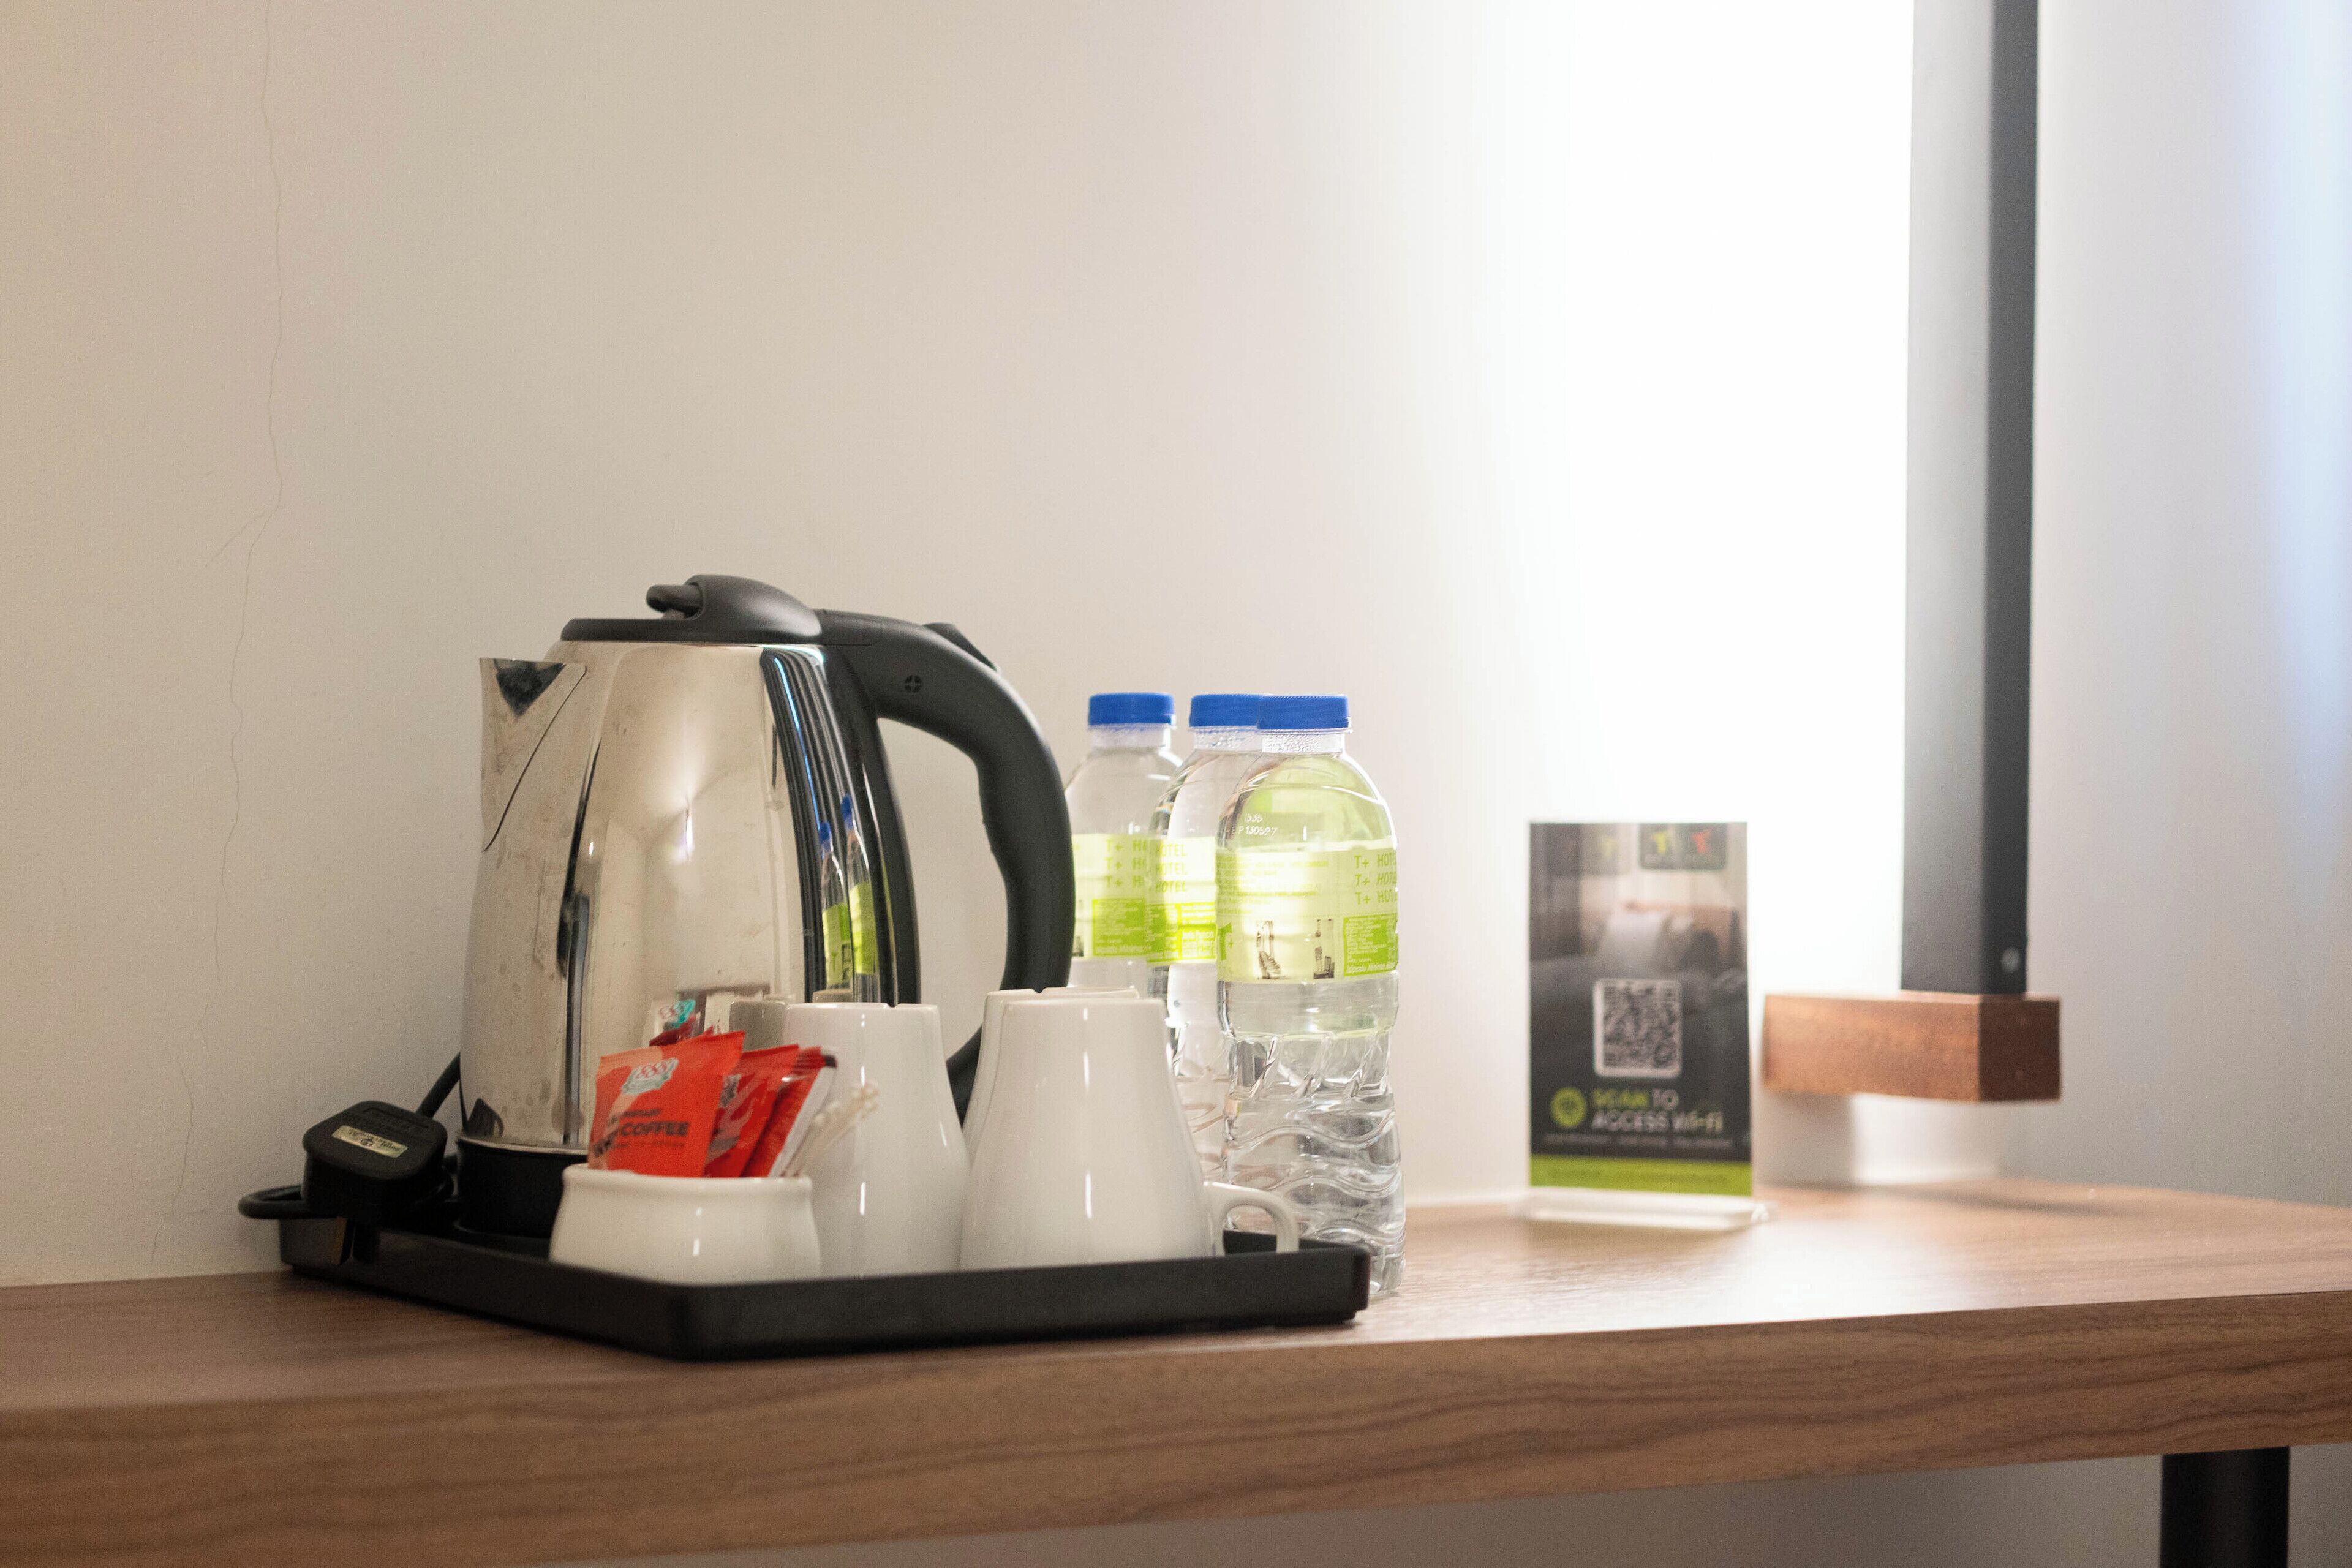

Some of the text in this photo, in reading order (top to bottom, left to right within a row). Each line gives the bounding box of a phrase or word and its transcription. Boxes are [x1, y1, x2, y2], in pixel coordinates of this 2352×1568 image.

[1354, 855, 1369, 868] T+
[1156, 880, 1186, 893] HOTEL
[1354, 874, 1370, 887] T+
[1355, 892, 1371, 905] T+
[1593, 1088, 1679, 1110] SCAN TO
[1592, 1110, 1670, 1133] ACCESS
[621, 1121, 690, 1137] COFFEE
